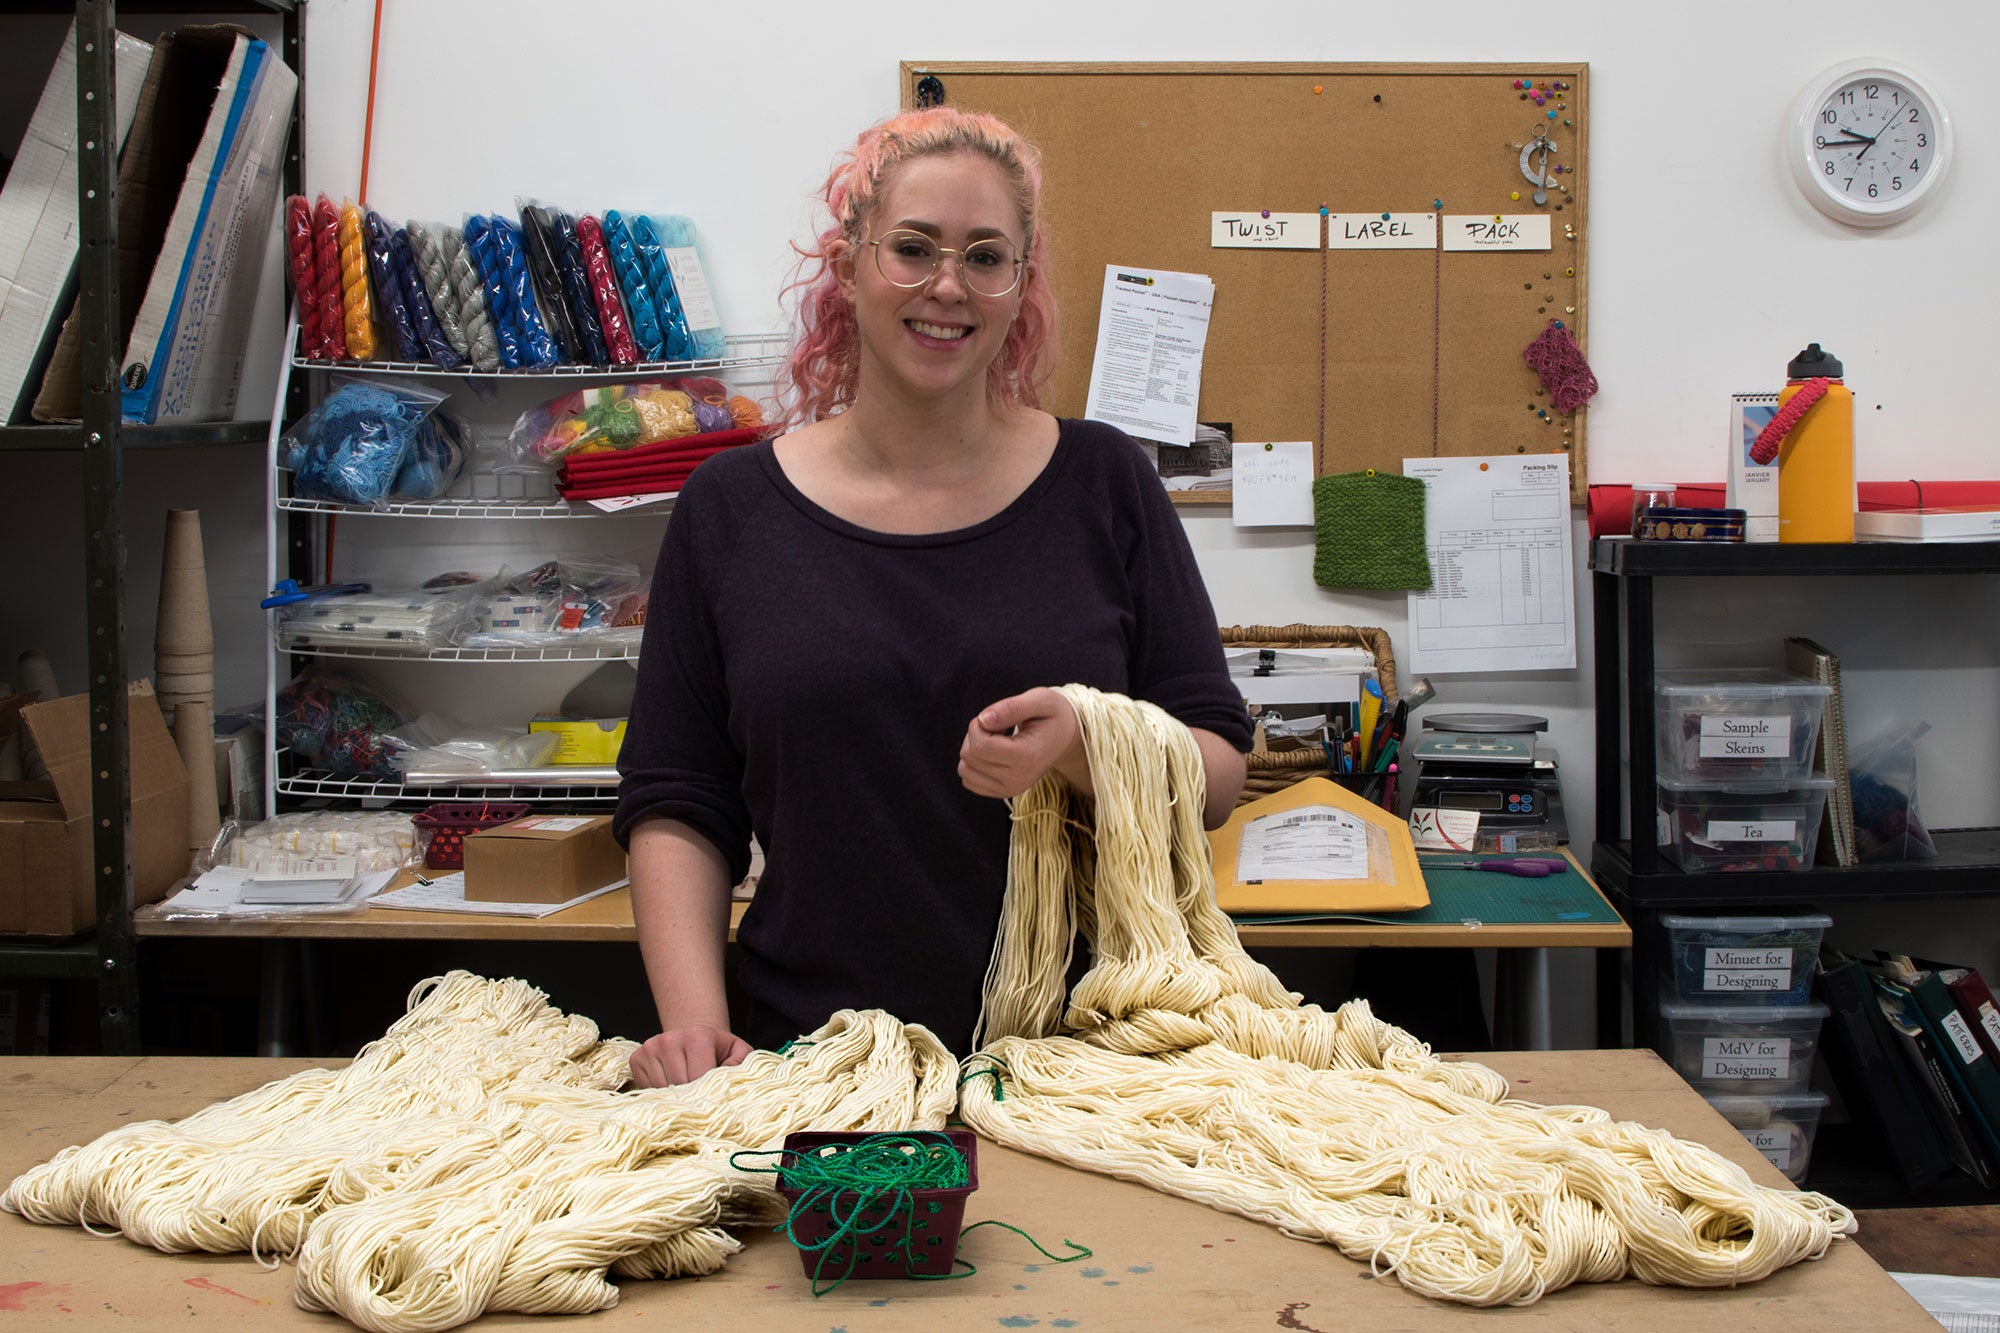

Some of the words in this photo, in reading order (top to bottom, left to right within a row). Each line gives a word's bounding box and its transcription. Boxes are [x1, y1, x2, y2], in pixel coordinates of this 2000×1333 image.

[1840, 92, 1854, 105] 11
[1863, 85, 1878, 99] 12
[1892, 92, 1898, 105] 1
[1821, 111, 1836, 124] 10
[1909, 109, 1918, 122] 2
[1816, 136, 1825, 149] 9
[1917, 134, 1927, 147] 3
[1825, 162, 1834, 175] 8
[1910, 159, 1919, 172] 4
[1844, 178, 1853, 191] 7
[1893, 177, 1901, 190] 5
[1868, 184, 1877, 197] 6
[1222, 219, 1288, 238] TWIST
[1345, 222, 1413, 239] LABEL
[1465, 222, 1519, 238] PACK
[1723, 720, 1769, 737] Sample
[1725, 742, 1765, 754] Skeins
[1741, 825, 1763, 838] Tea
[1715, 952, 1761, 965] Minuet
[1765, 952, 1783, 964] for
[1717, 974, 1779, 990] Designing
[1987, 1014, 2000, 1038] PATT
[1948, 1014, 1976, 1057] PATTERNS
[1719, 1042, 1754, 1055] MdV
[1758, 1042, 1776, 1055] for
[1715, 1063, 1777, 1079] Designing
[1756, 1133, 1774, 1145] for
